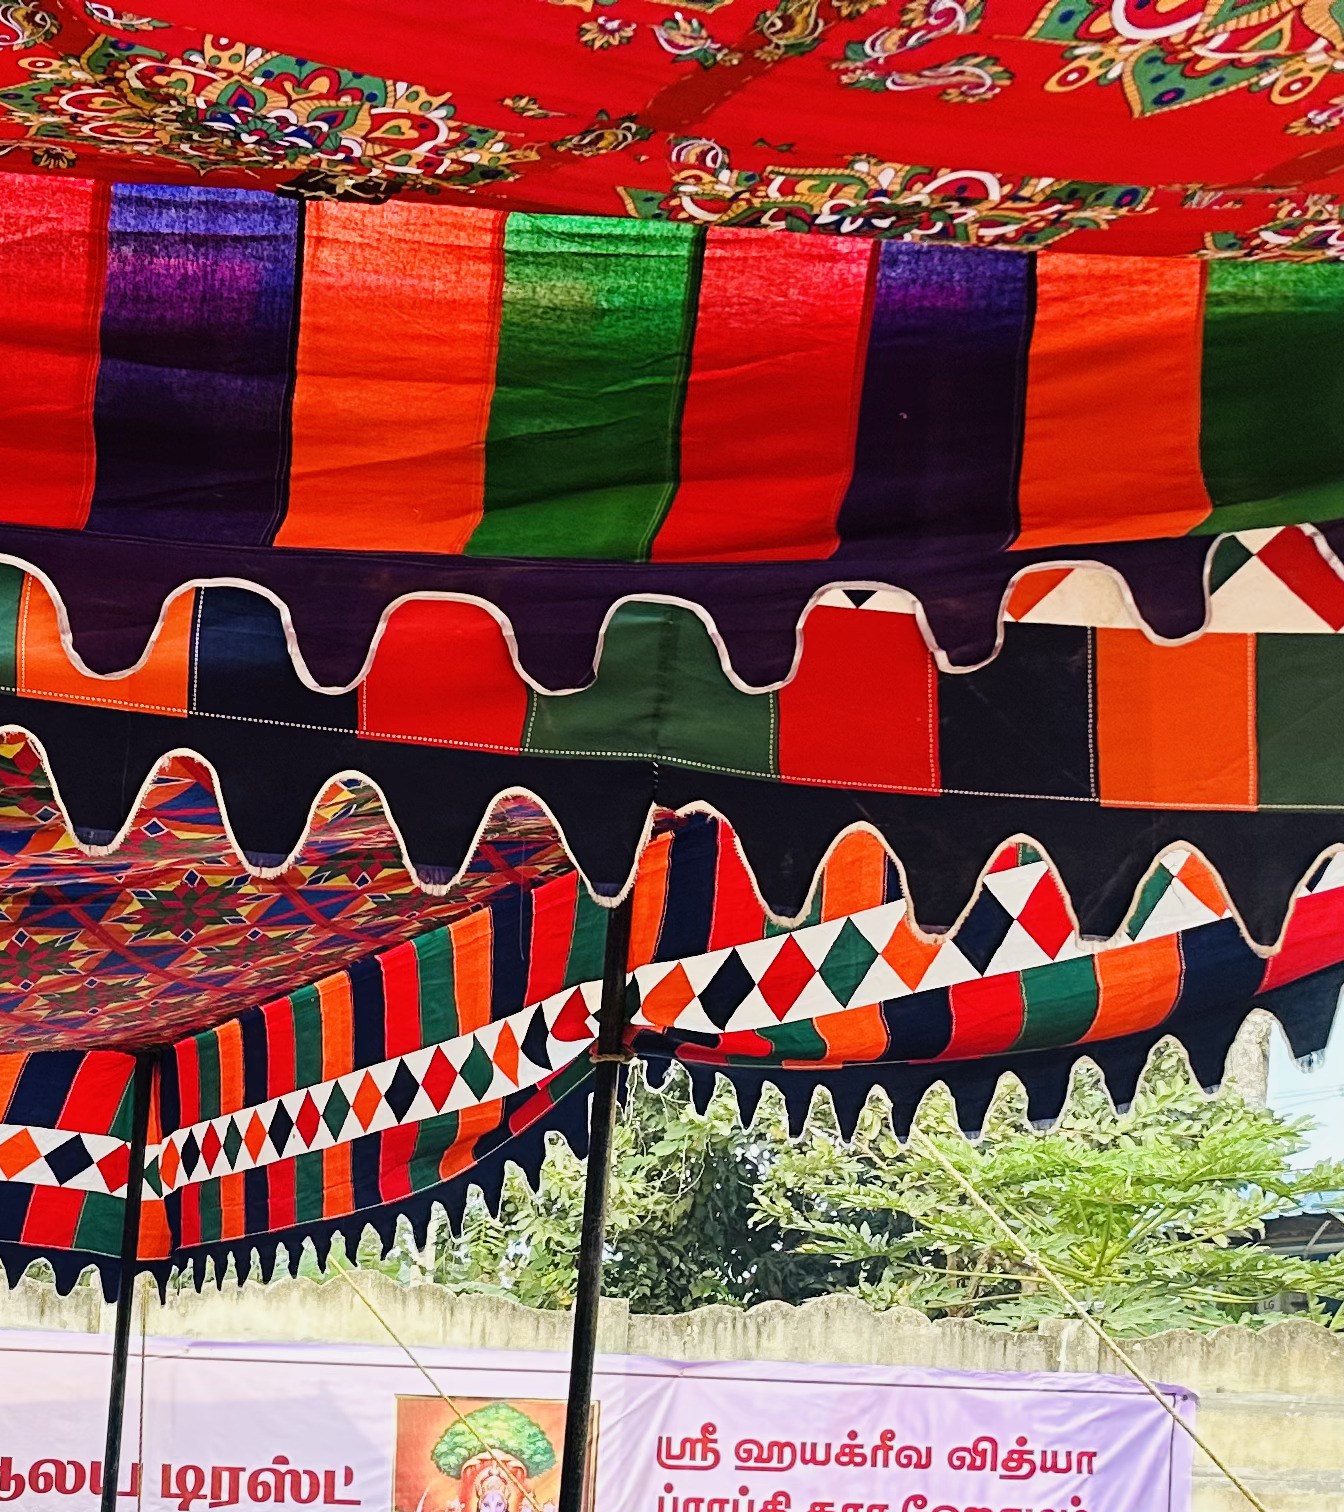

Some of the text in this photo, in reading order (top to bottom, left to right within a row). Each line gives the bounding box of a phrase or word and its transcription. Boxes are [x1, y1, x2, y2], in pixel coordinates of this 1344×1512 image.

[734, 1429, 933, 1472] ஹயக்ரீவ
[947, 1435, 1098, 1480] வித்யா
[161, 1455, 362, 1512] டிரஸ்ட்
